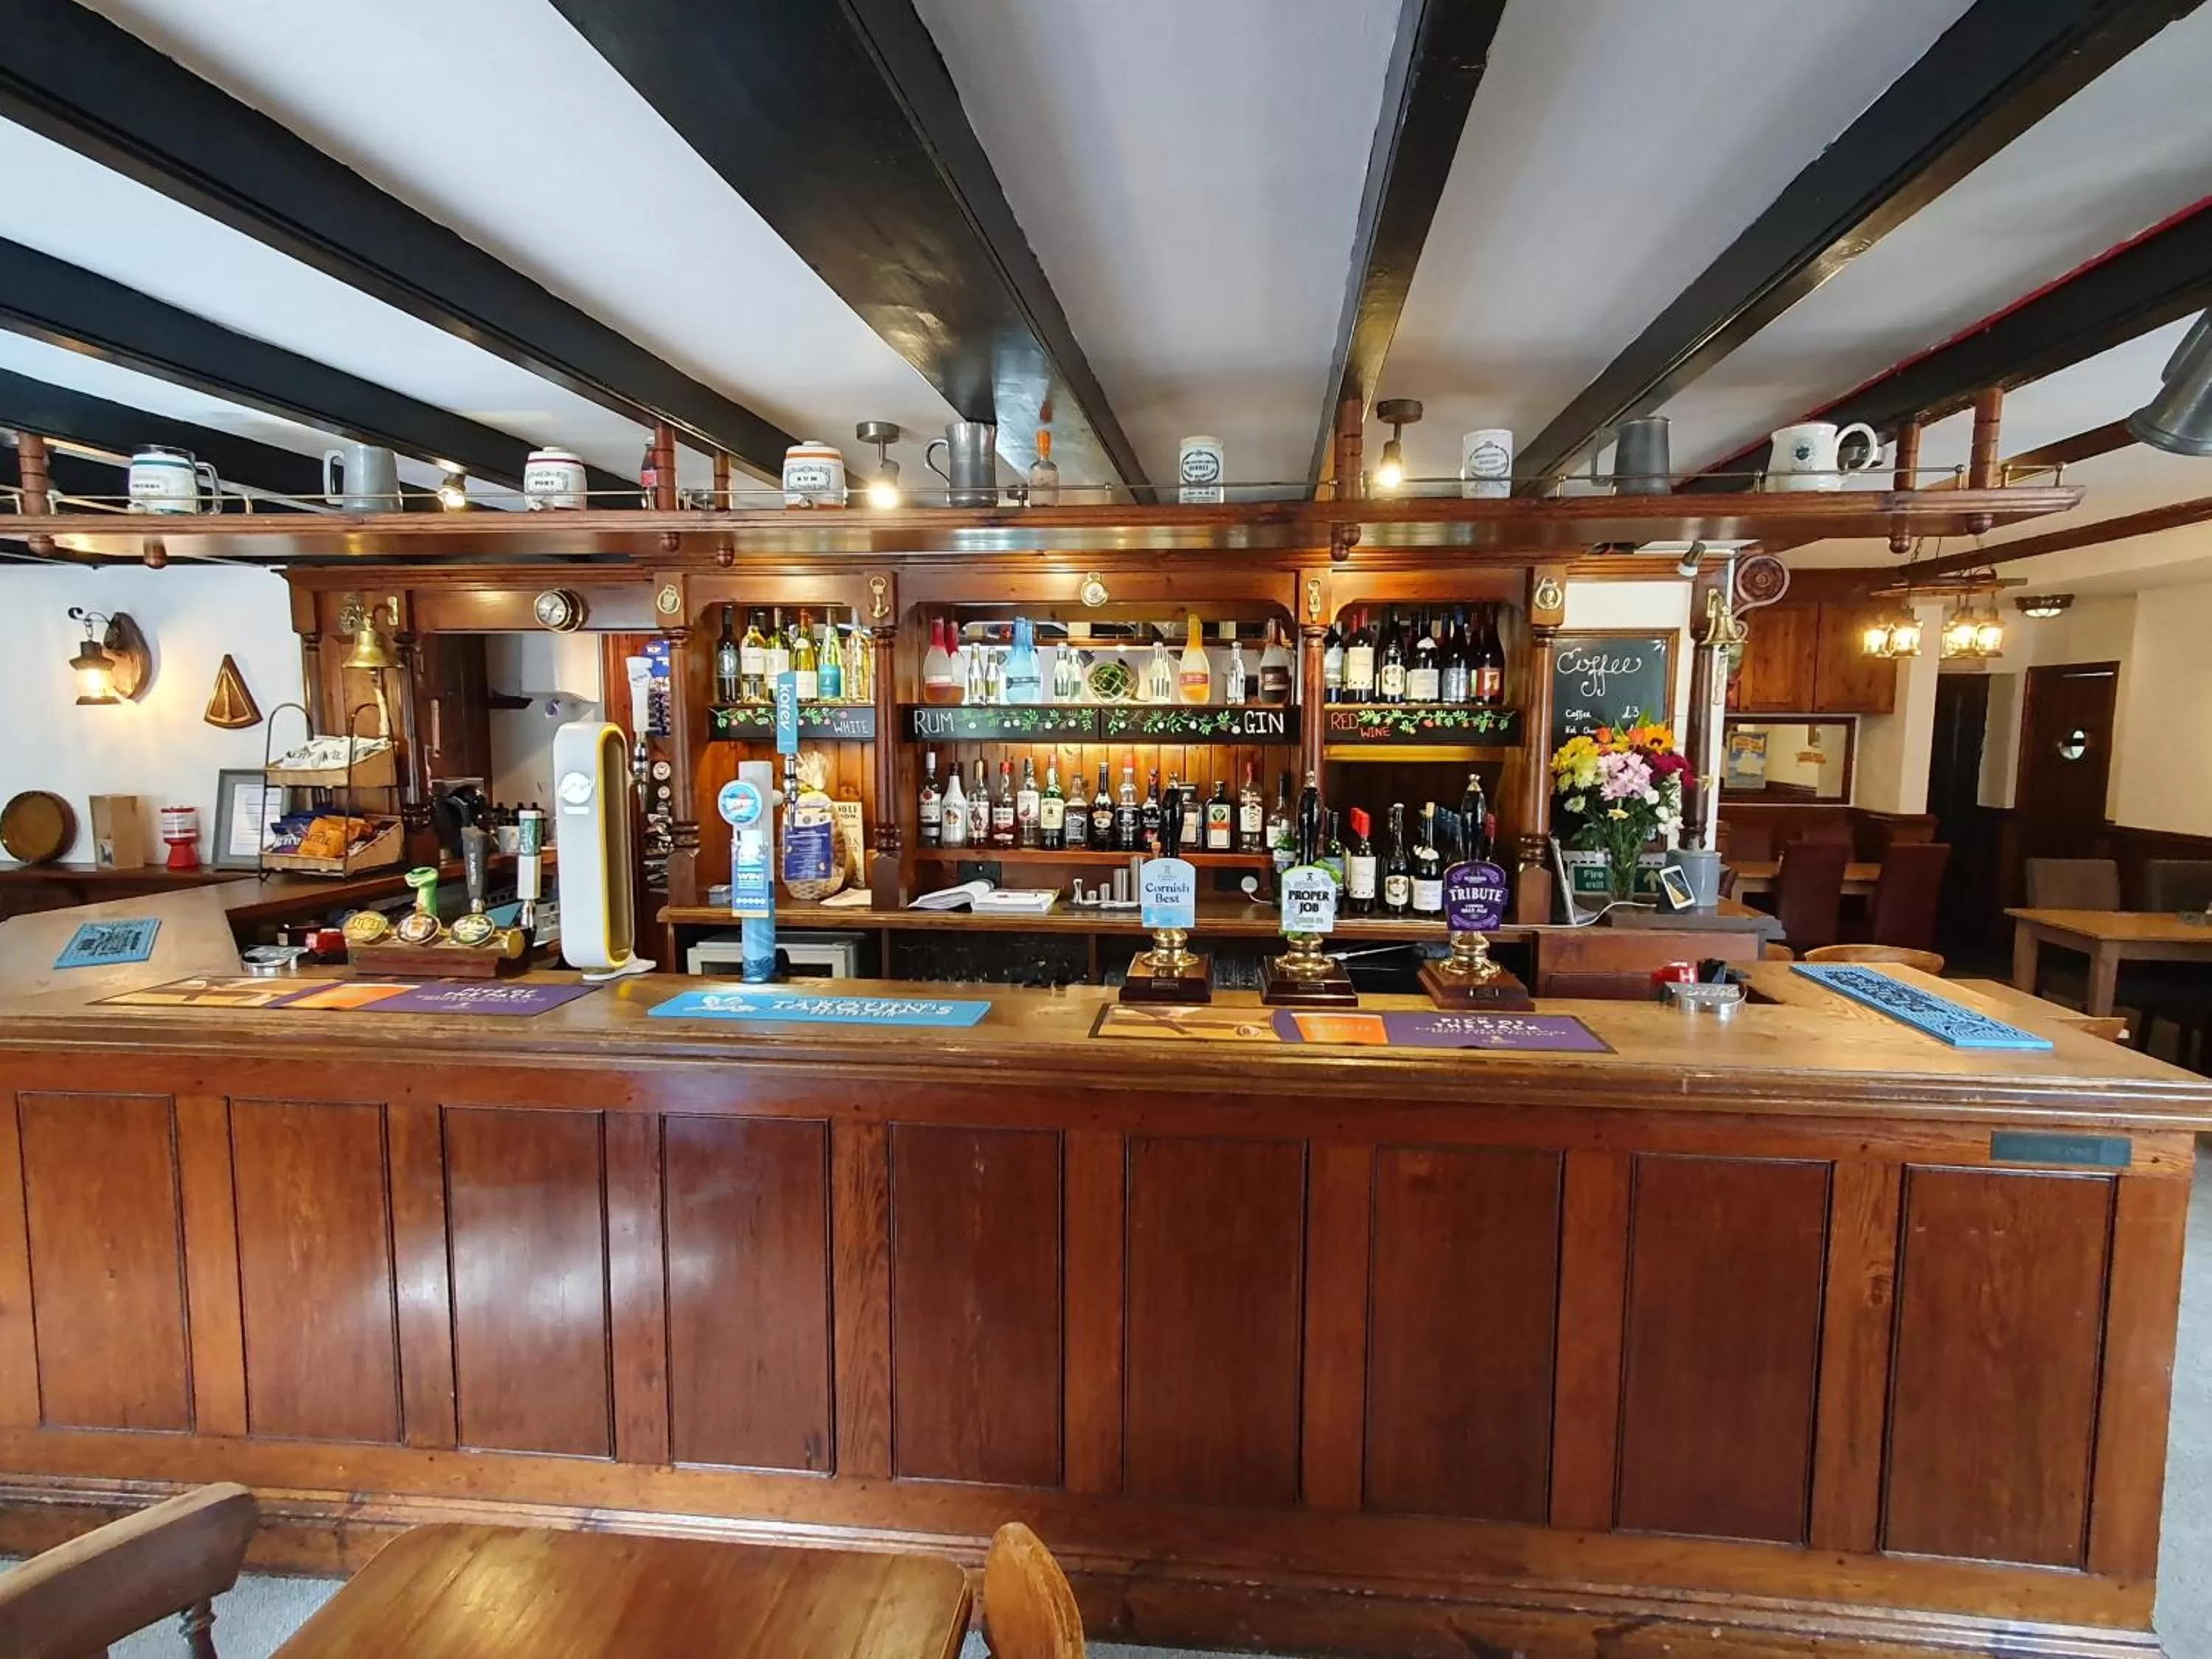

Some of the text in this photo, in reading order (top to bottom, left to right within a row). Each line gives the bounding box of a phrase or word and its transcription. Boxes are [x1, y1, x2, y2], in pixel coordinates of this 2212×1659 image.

[1557, 647, 1642, 697] Coffee
[779, 684, 793, 731] korev
[1565, 709, 1592, 720] Coffee
[832, 720, 869, 734] WHITE
[914, 710, 955, 734] RUM
[1244, 710, 1284, 734] GIN
[1331, 712, 1359, 731] RED
[1360, 726, 1392, 738] WINE
[1583, 869, 1605, 880] Fire
[1145, 882, 1189, 893] Cornish
[1585, 880, 1605, 889] exit
[1155, 893, 1180, 903] Best
[1288, 890, 1329, 901] PROPER
[1449, 887, 1503, 902] TRIBUTE
[1299, 902, 1319, 914] JOB
